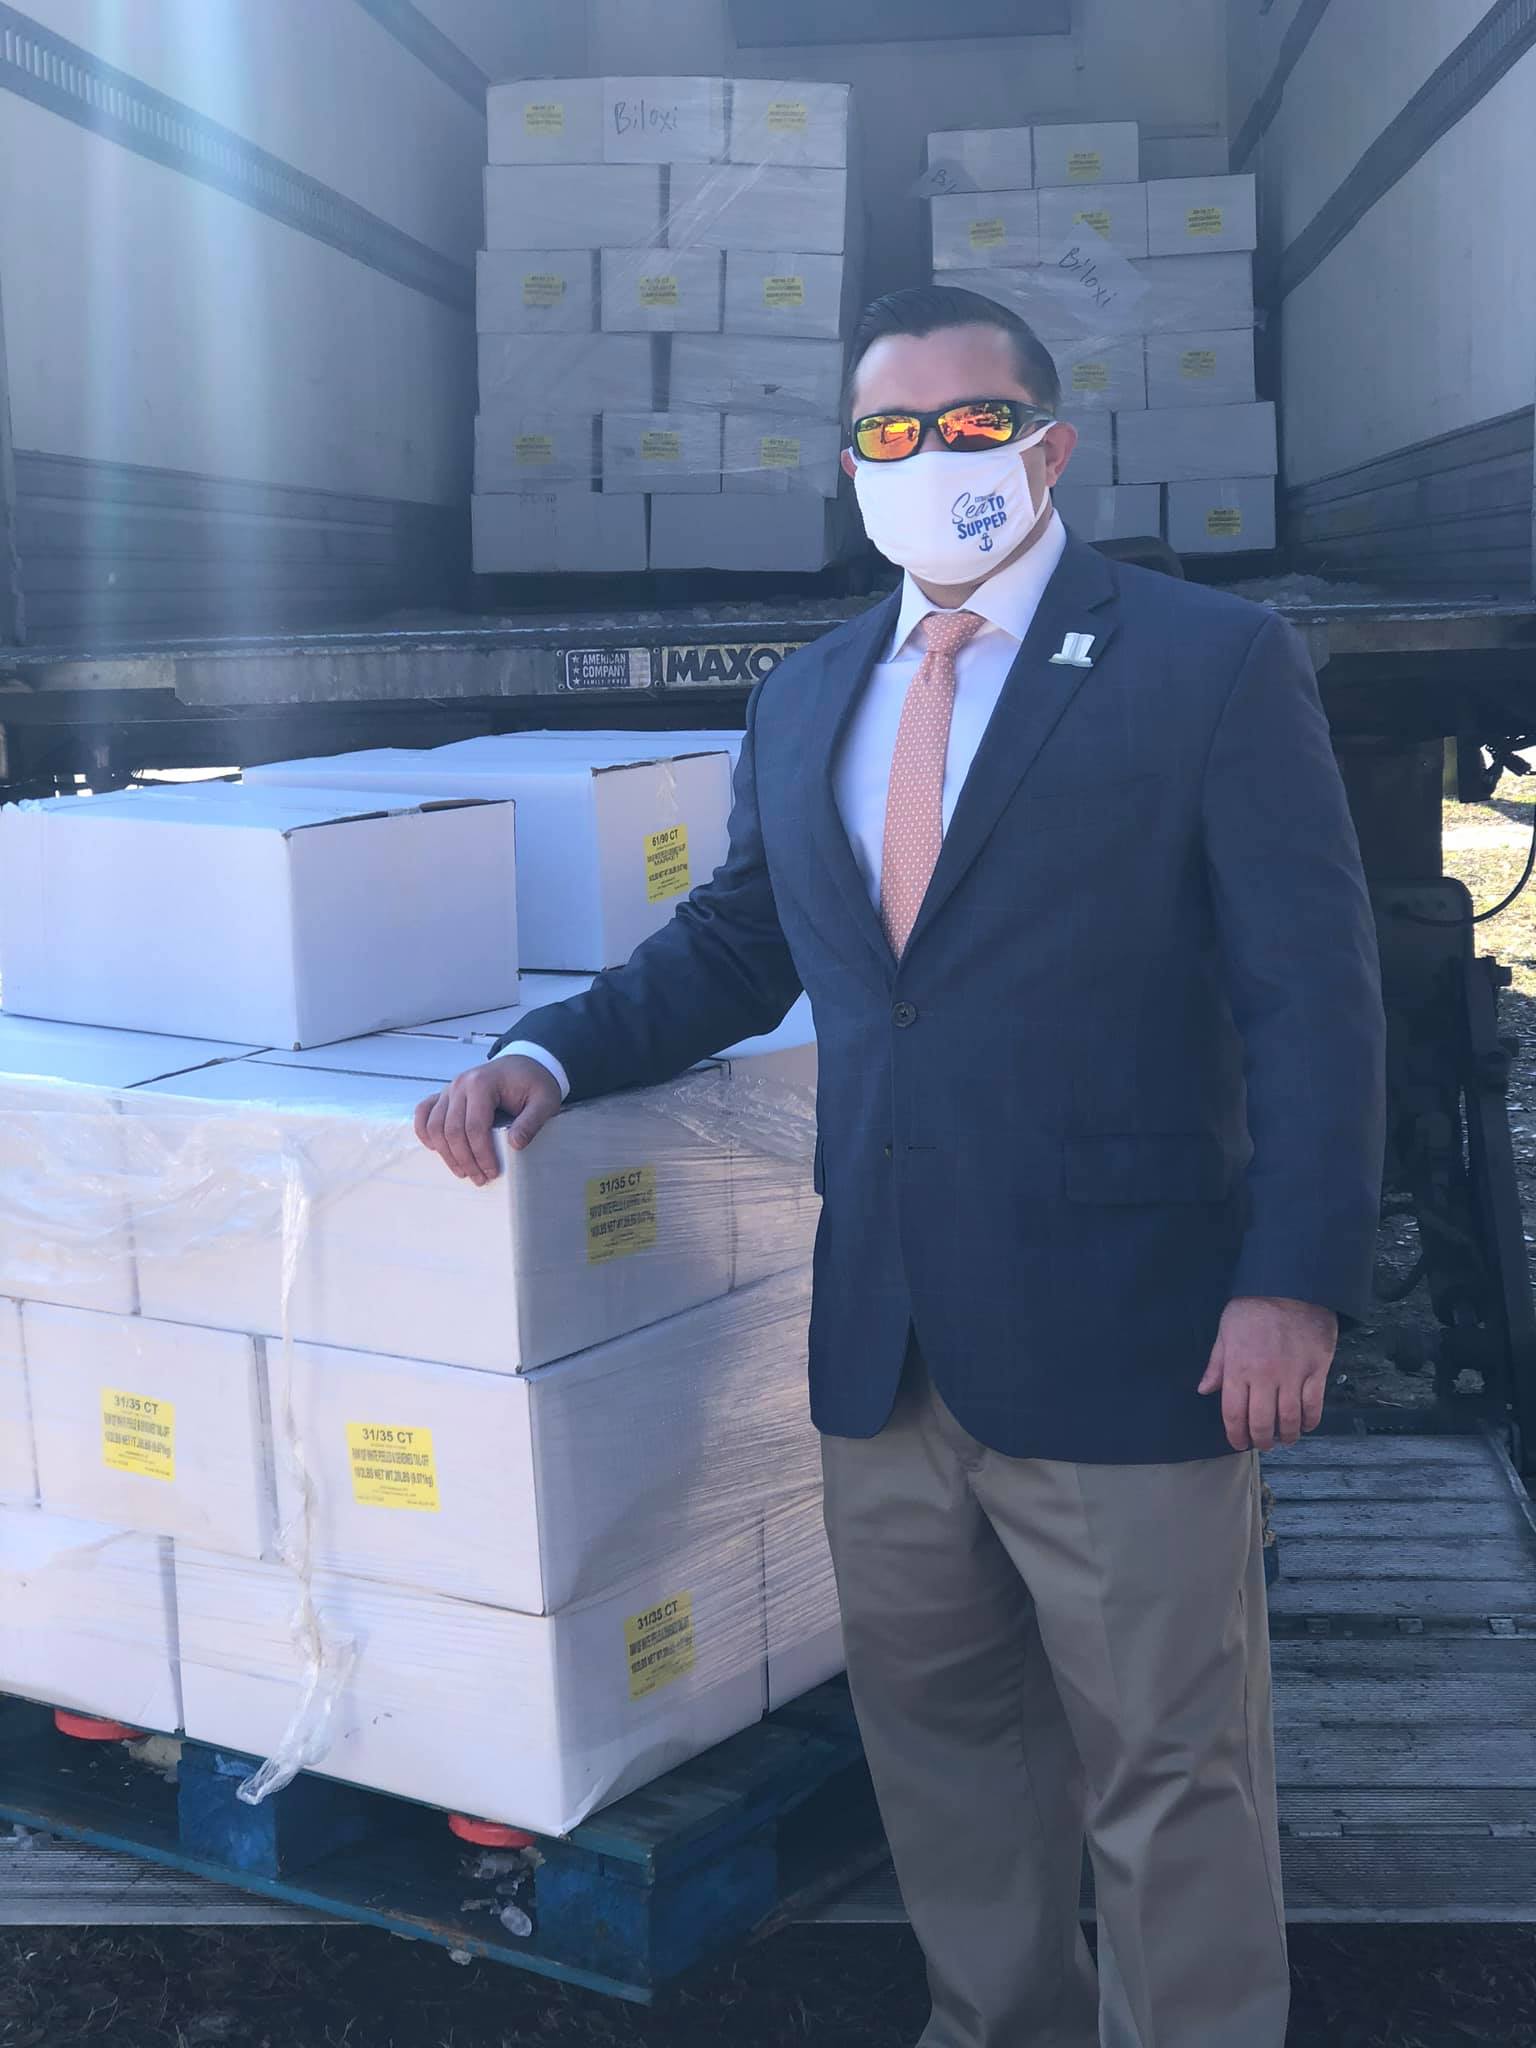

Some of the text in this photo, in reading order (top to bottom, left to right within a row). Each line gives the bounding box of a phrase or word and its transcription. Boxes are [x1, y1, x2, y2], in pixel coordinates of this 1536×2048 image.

[614, 99, 679, 135] Biloxi
[1058, 247, 1118, 308] Biloxi
[951, 491, 988, 524] Sea
[988, 495, 1005, 511] TO
[957, 511, 1007, 540] SUPPER
[583, 653, 627, 665] AMERICAN
[583, 665, 626, 678] COMPANY
[669, 829, 679, 841] CT
[600, 1171, 642, 1195] 31/35 CT
[114, 1395, 159, 1415] 31/35 CT
[362, 1428, 414, 1444] 31/35 CT
[636, 1600, 678, 1630] 31/35 CT
